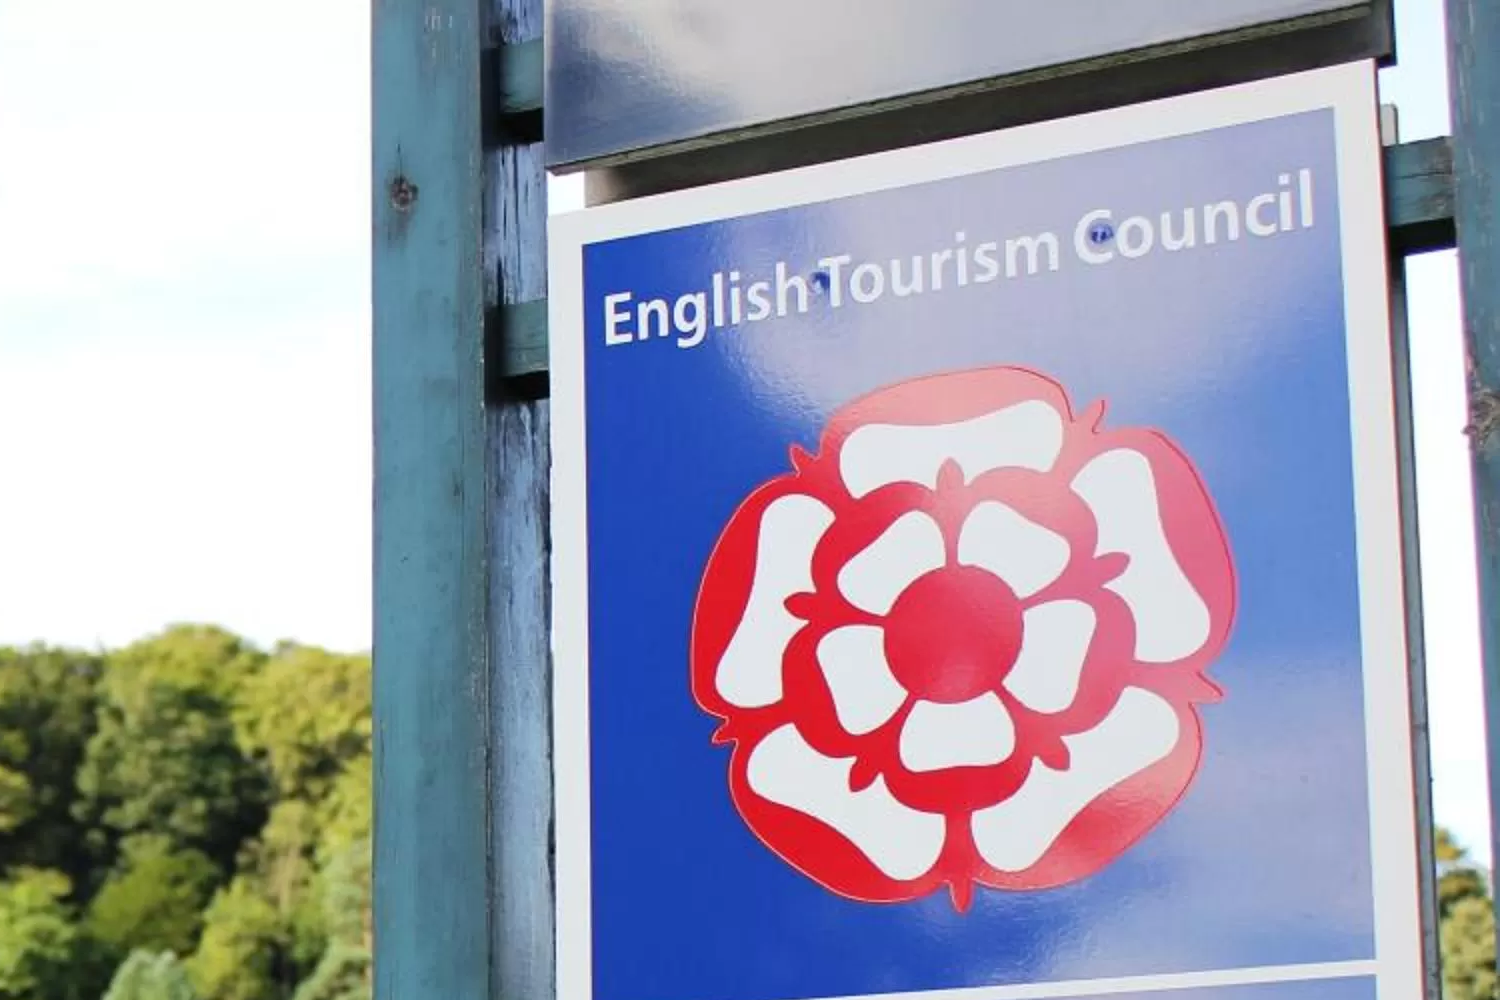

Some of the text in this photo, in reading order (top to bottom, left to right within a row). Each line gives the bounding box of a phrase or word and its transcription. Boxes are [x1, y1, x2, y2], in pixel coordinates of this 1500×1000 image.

[603, 167, 1315, 349] English Tourism Council
